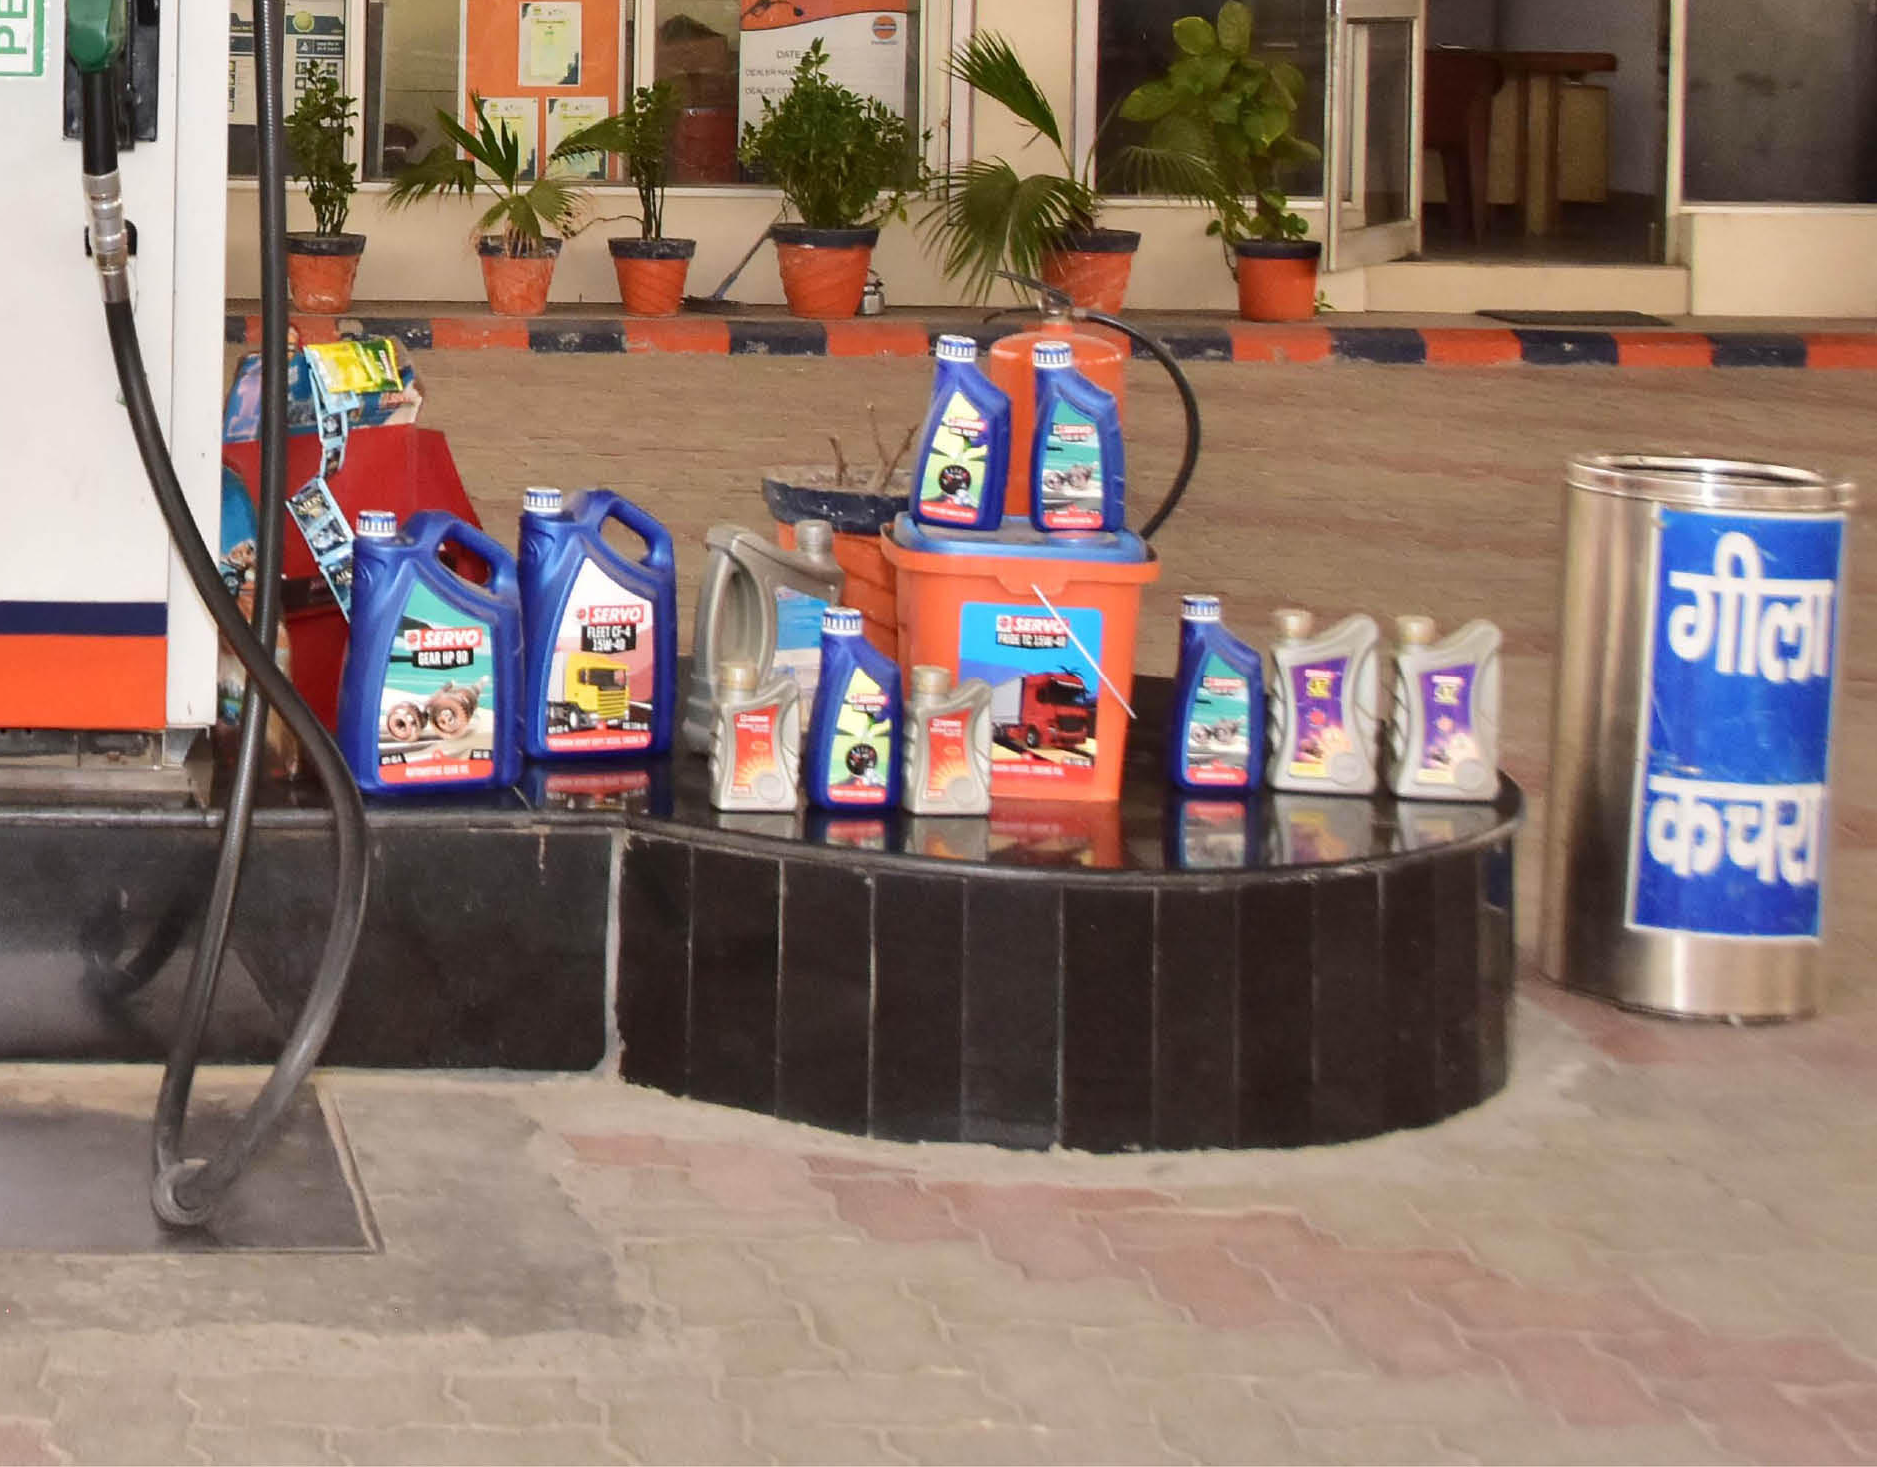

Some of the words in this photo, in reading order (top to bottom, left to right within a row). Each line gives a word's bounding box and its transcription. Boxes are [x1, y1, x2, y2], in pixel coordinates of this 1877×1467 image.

[591, 606, 641, 623] SERVO
[1668, 531, 1834, 683] गीला
[423, 629, 479, 648] SERVO
[587, 625, 610, 638] FLEET
[591, 637, 626, 651] 15W-40
[418, 652, 441, 666] GEAR
[443, 651, 455, 665] HP
[456, 651, 469, 664] 90
